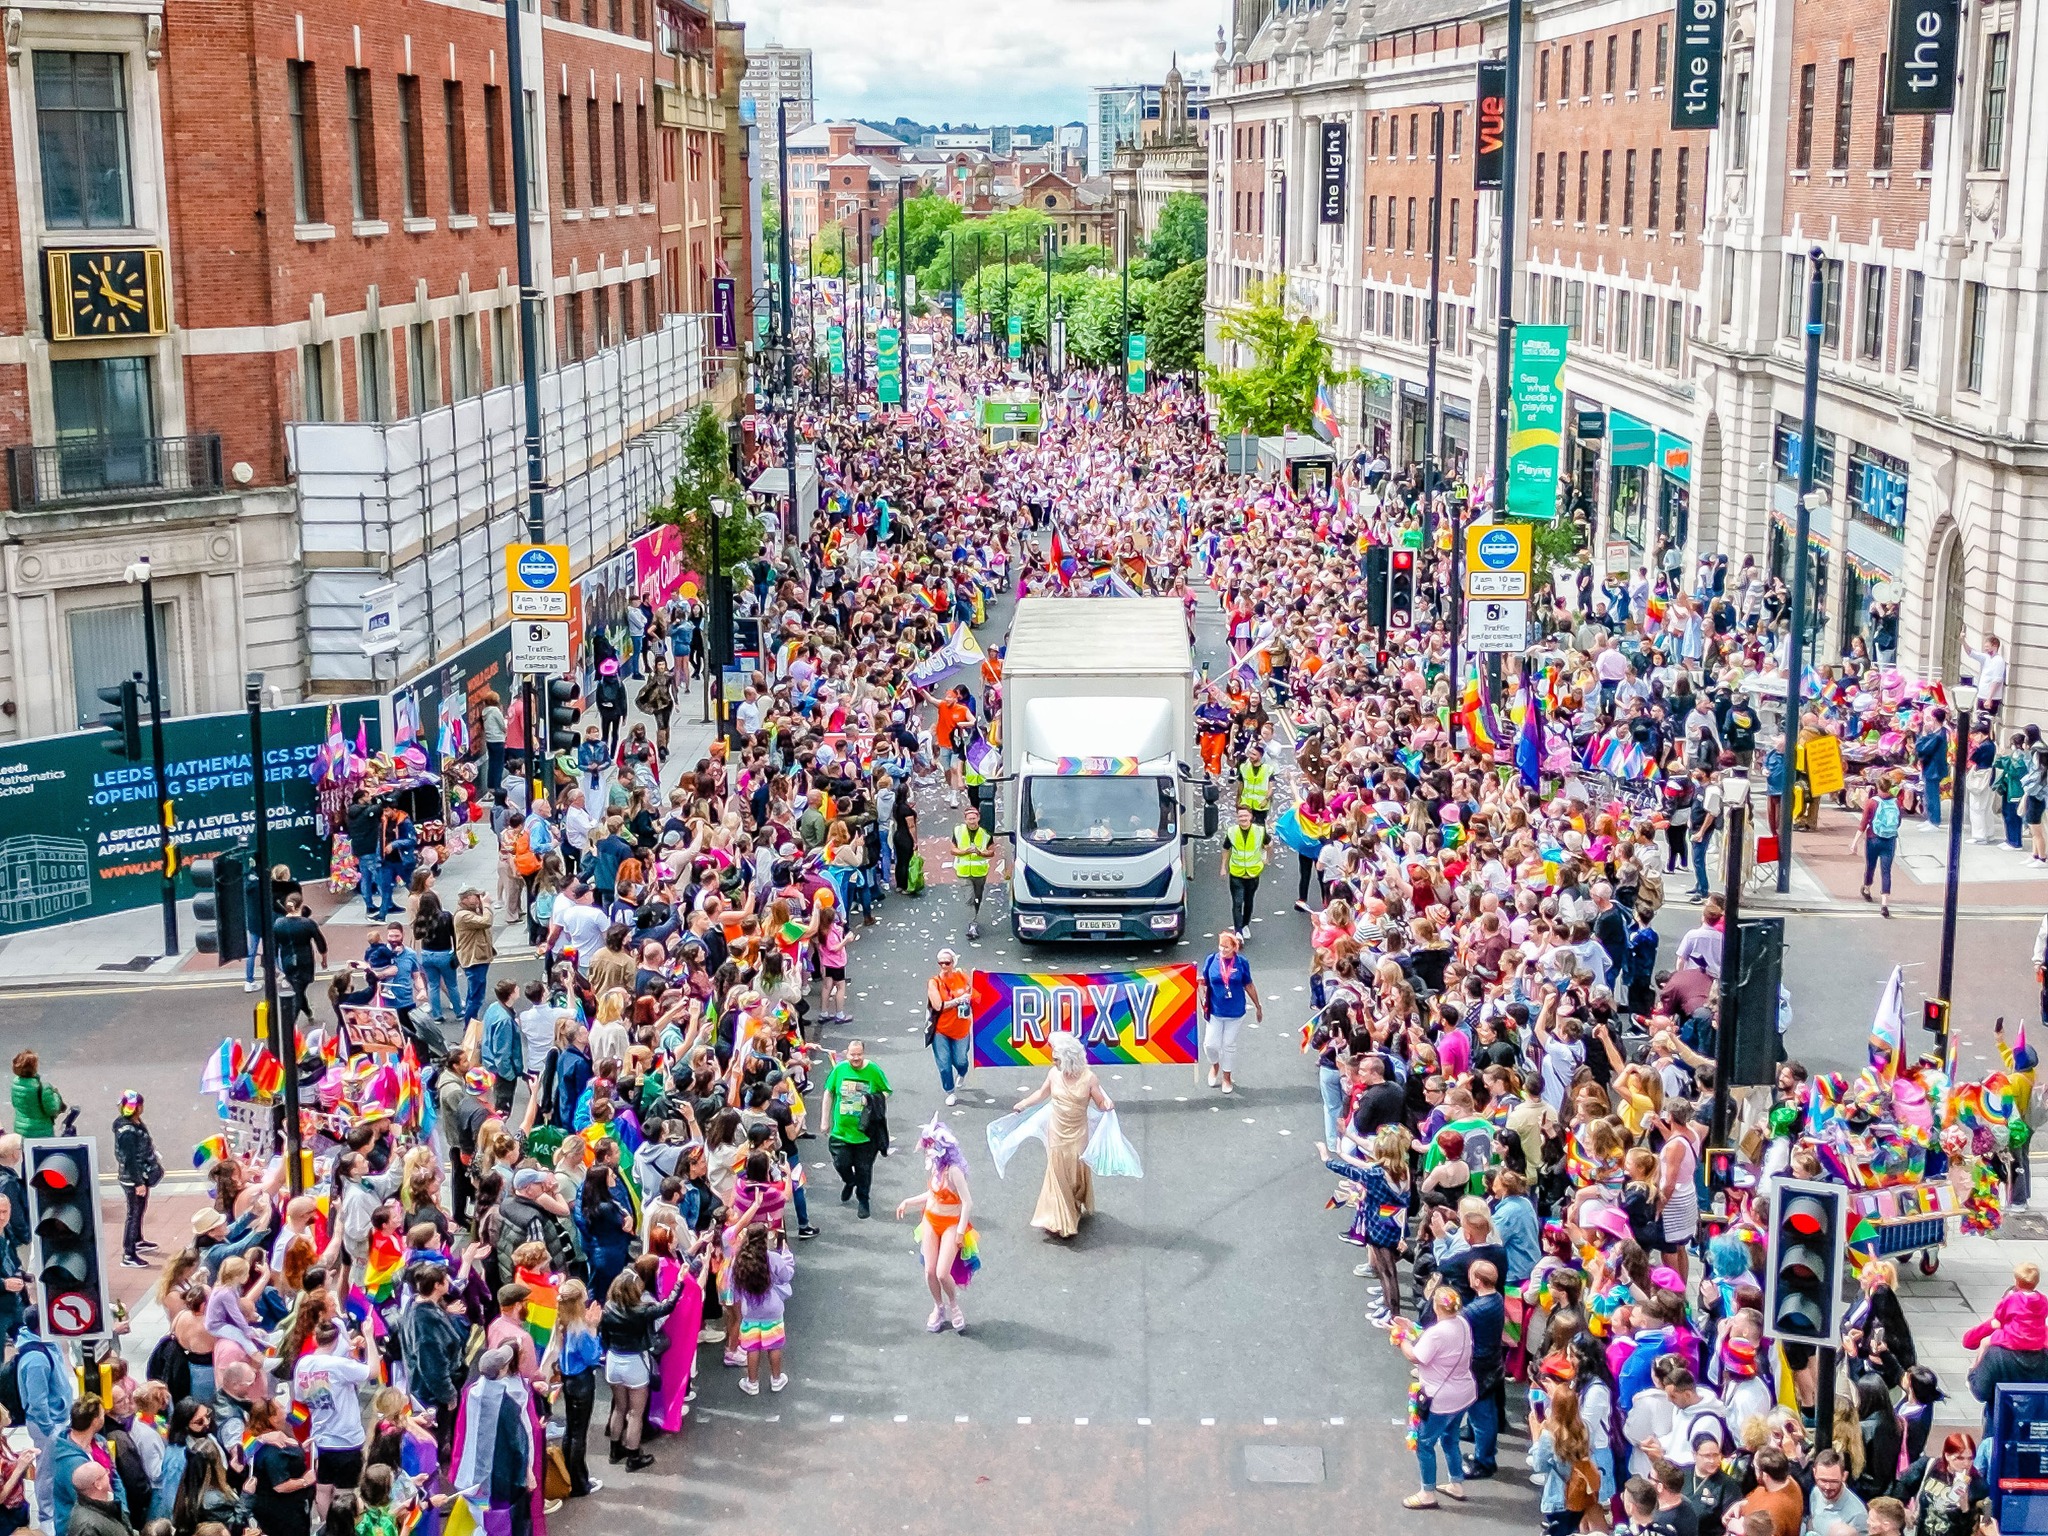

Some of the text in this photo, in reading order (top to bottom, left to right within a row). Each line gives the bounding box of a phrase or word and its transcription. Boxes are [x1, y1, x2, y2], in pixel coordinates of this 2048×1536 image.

[1904, 11, 1942, 93] the
[1683, 56, 1708, 115] the
[1480, 96, 1505, 155] vue
[1325, 130, 1343, 216] the light
[1520, 373, 1539, 383] See
[1527, 383, 1550, 393] what
[1519, 392, 1557, 402] Leeds is
[1521, 402, 1554, 414] playing
[1527, 413, 1537, 421] at
[1517, 463, 1552, 478] Playing
[1471, 632, 1523, 641] enforcement
[527, 645, 554, 653] Traffic
[1479, 641, 1514, 649] cameras
[515, 653, 567, 662] enforcement
[524, 662, 558, 670] cameras
[0, 762, 29, 775] eeds
[93, 766, 155, 788] LEEDS
[164, 748, 289, 778] MATHEMAICS
[97, 805, 294, 843] A SPECIALST A LEVEL SCOOL
[98, 815, 315, 857] APPLICATONS ARE NOW PEN AT:
[1071, 869, 1125, 881] IVECO
[1012, 983, 1158, 1049] ROXY
